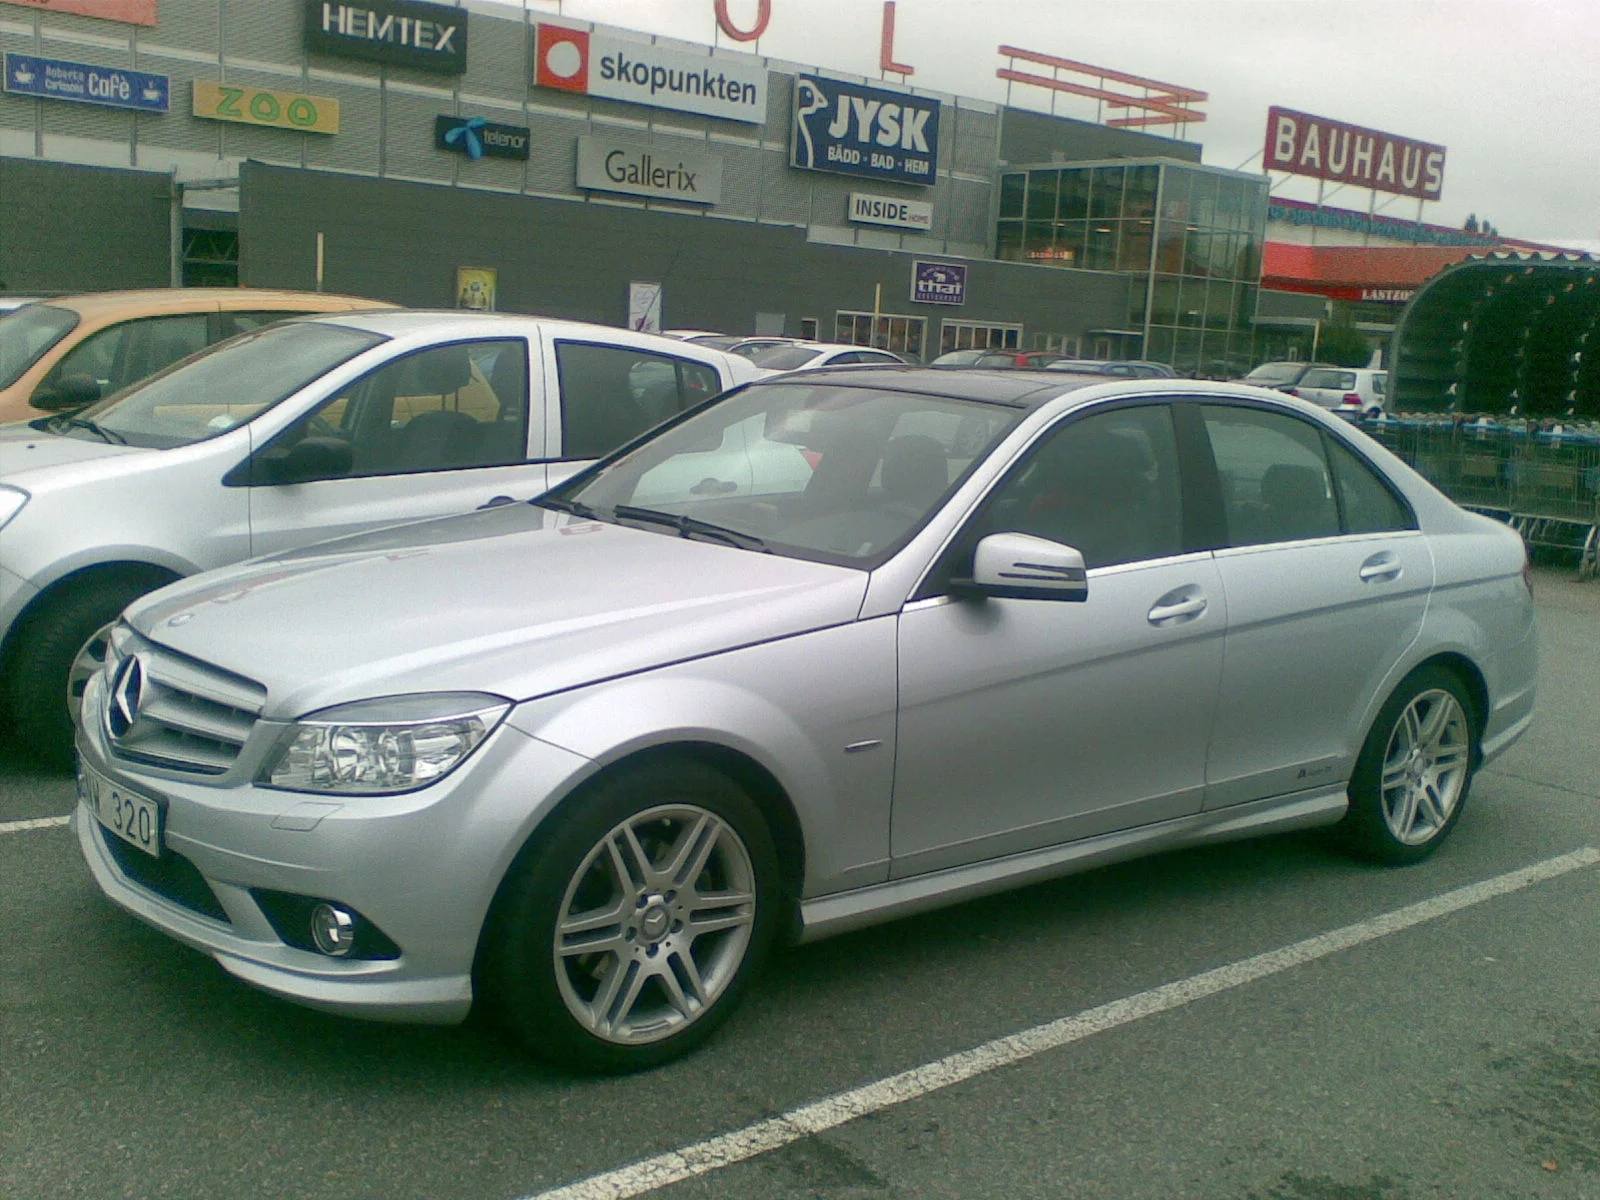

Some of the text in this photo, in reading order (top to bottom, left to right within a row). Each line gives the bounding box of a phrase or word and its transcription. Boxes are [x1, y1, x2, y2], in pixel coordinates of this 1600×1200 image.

[322, 2, 456, 54] HEMTEX
[600, 52, 757, 105] skopunkten
[483, 128, 527, 148] telenor
[828, 94, 931, 153] JYSK
[604, 150, 698, 192] Gallerix
[827, 143, 930, 175] BÅDD BAD HEM
[1273, 115, 1443, 193] BAUHAUS
[856, 198, 909, 222] INSIDE
[918, 279, 962, 295] thai
